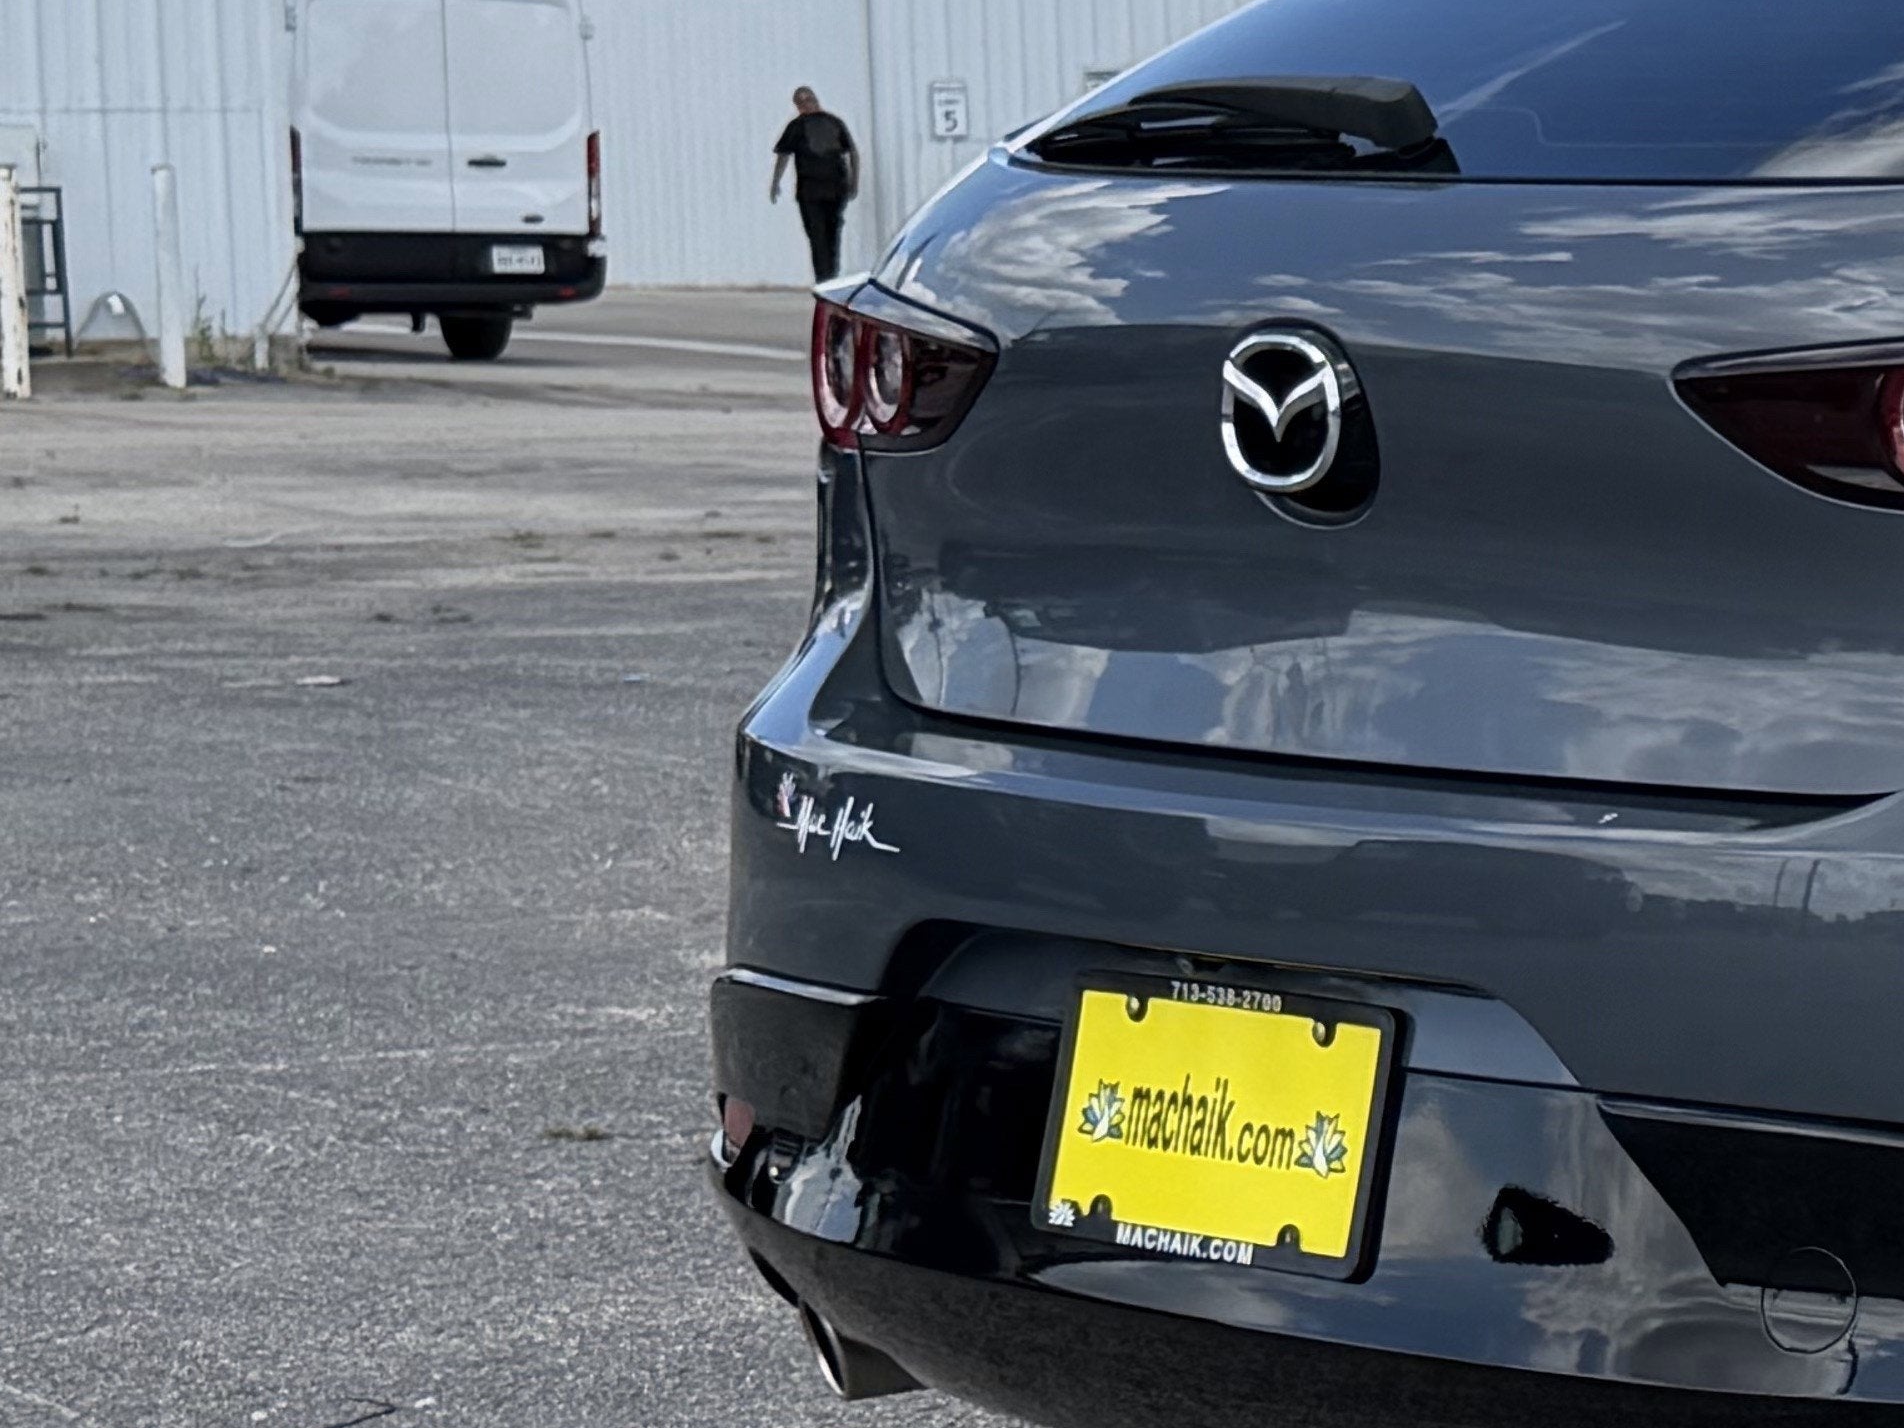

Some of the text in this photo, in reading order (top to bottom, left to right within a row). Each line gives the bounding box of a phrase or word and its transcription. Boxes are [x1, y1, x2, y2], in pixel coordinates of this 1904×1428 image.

[944, 109, 958, 132] 5
[1171, 980, 1282, 1012] 713-538-2700
[1124, 1073, 1295, 1170] machaik.com
[1115, 1222, 1254, 1265] MACHAIK.COM
